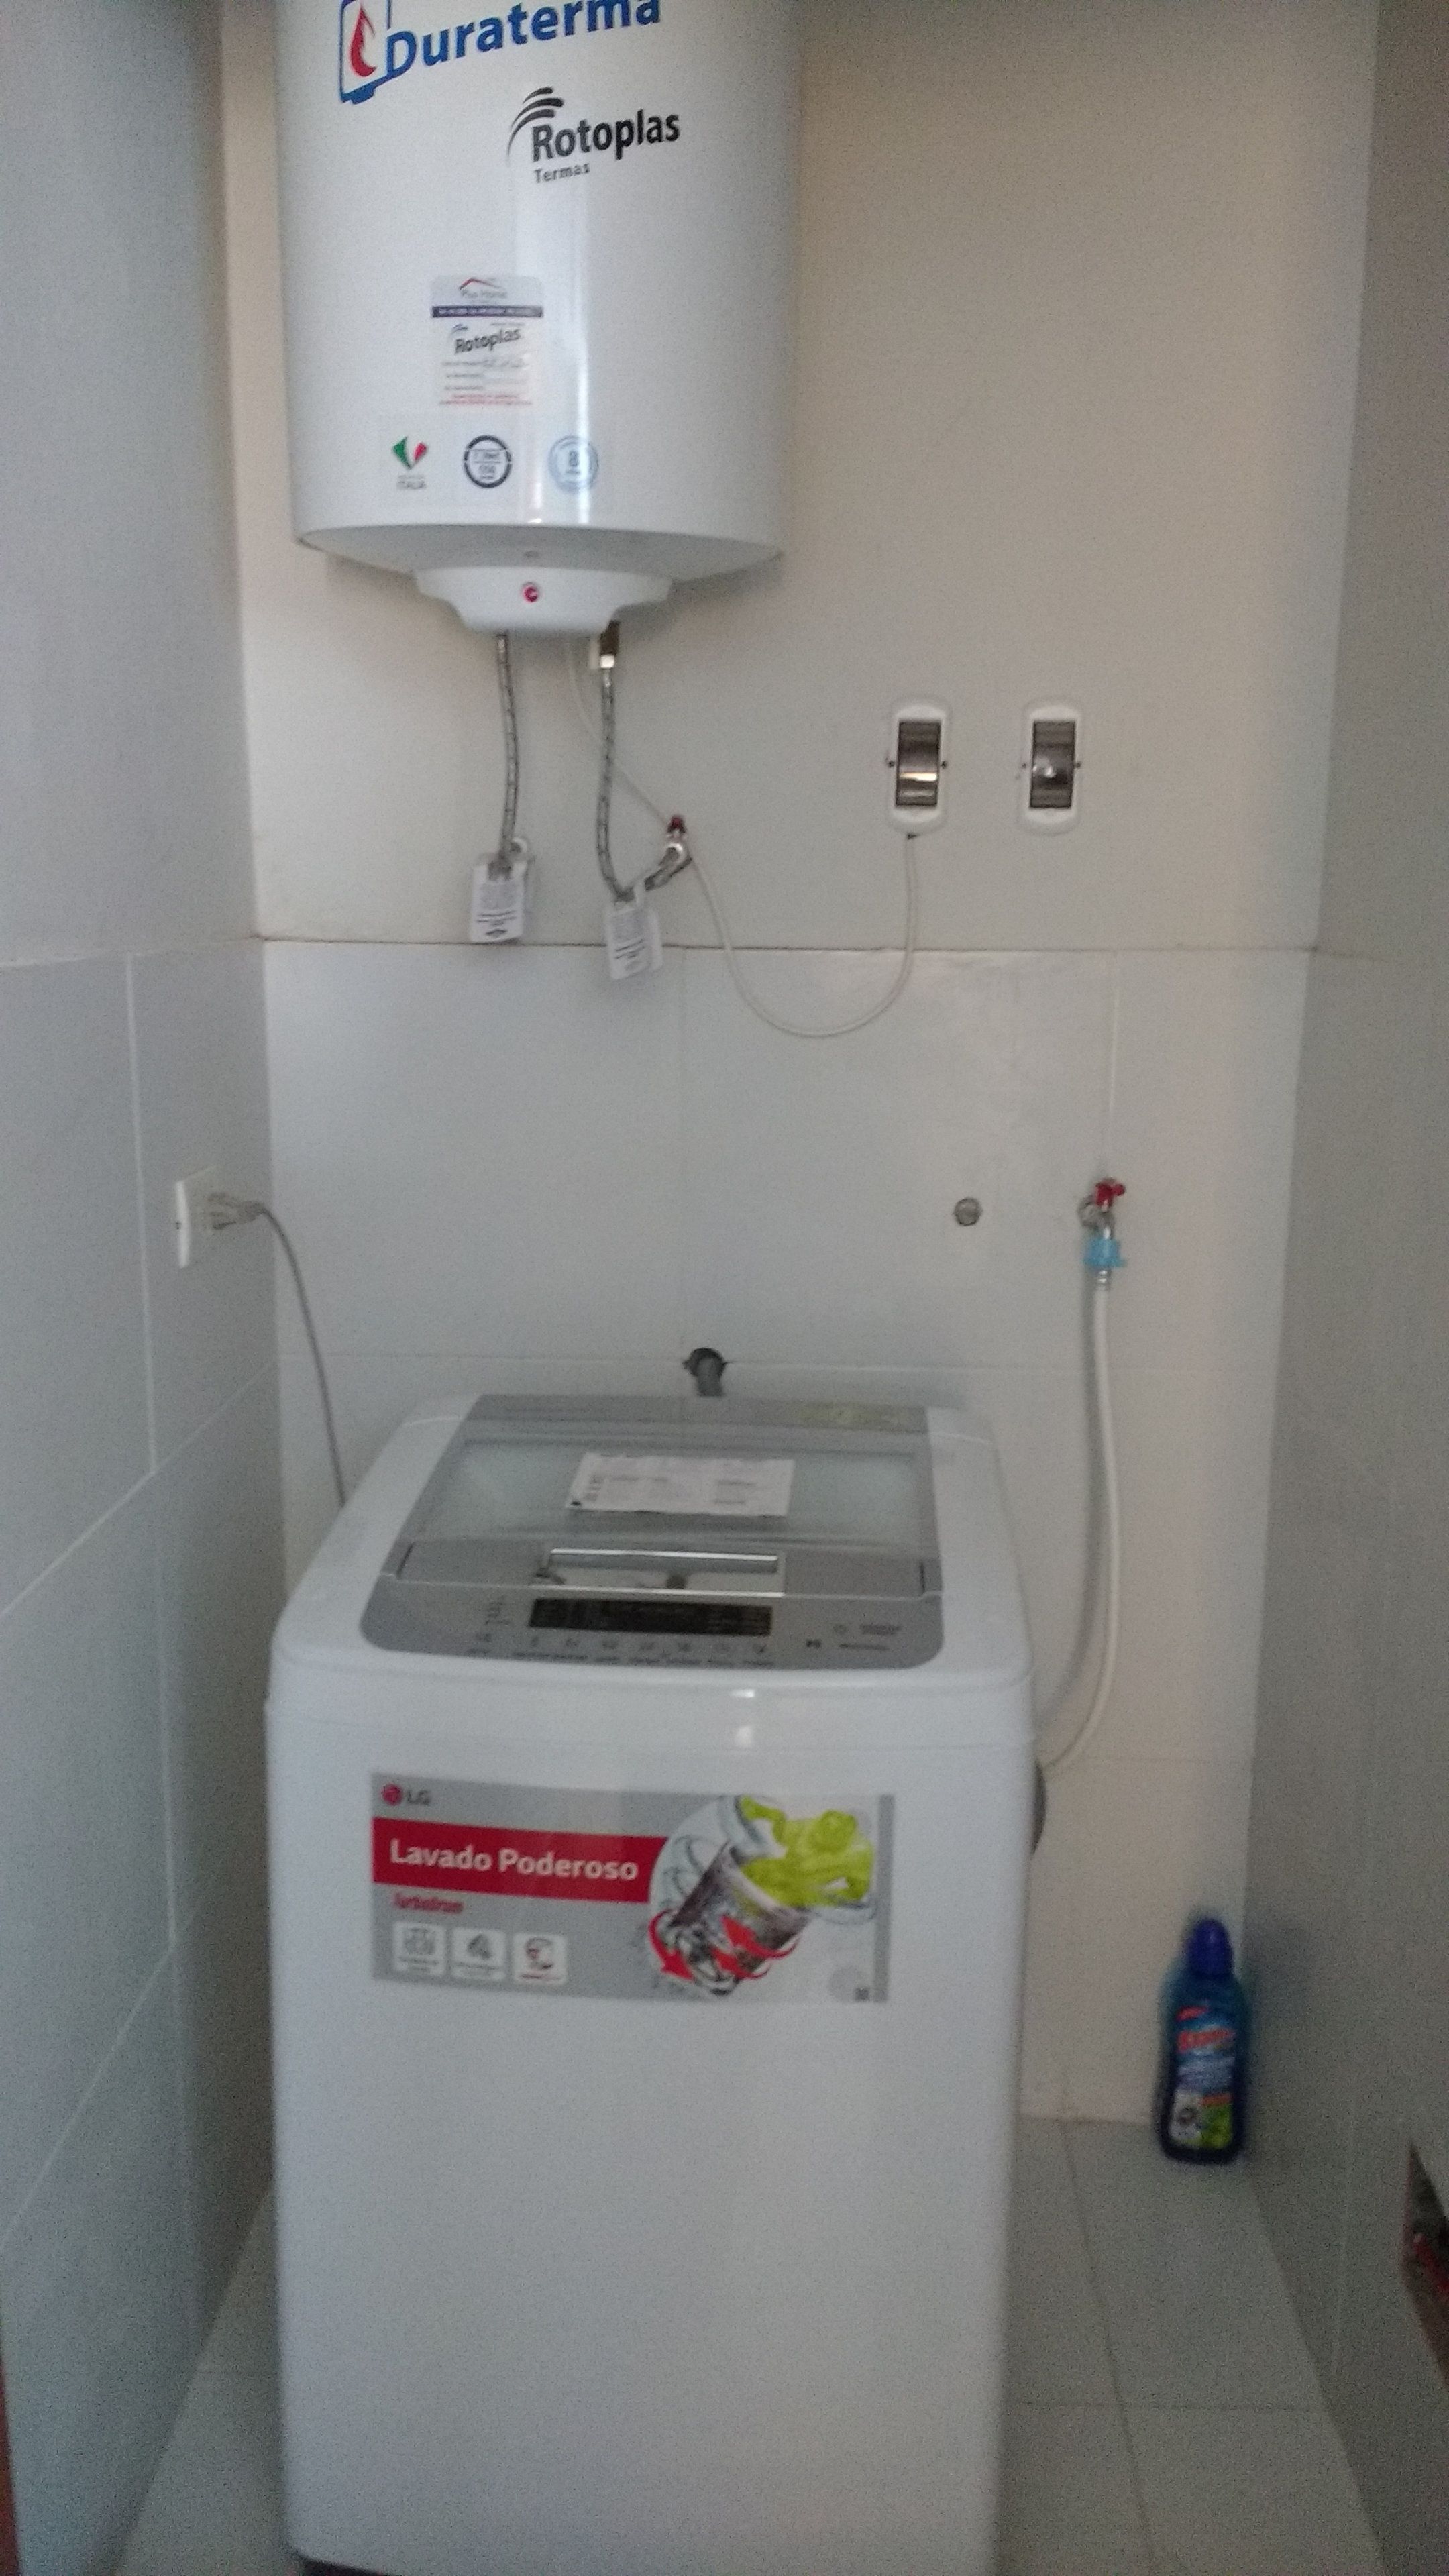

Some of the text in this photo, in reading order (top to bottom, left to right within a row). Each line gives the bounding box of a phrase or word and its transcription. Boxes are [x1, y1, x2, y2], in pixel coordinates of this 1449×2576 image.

[385, 0, 661, 78] Duraterma
[532, 109, 681, 161] Rotoplas
[534, 162, 590, 184] Termas
[454, 328, 521, 354] Rotoplas
[407, 1790, 431, 1805] LG
[390, 1838, 639, 1880] Lavado Poderoso
